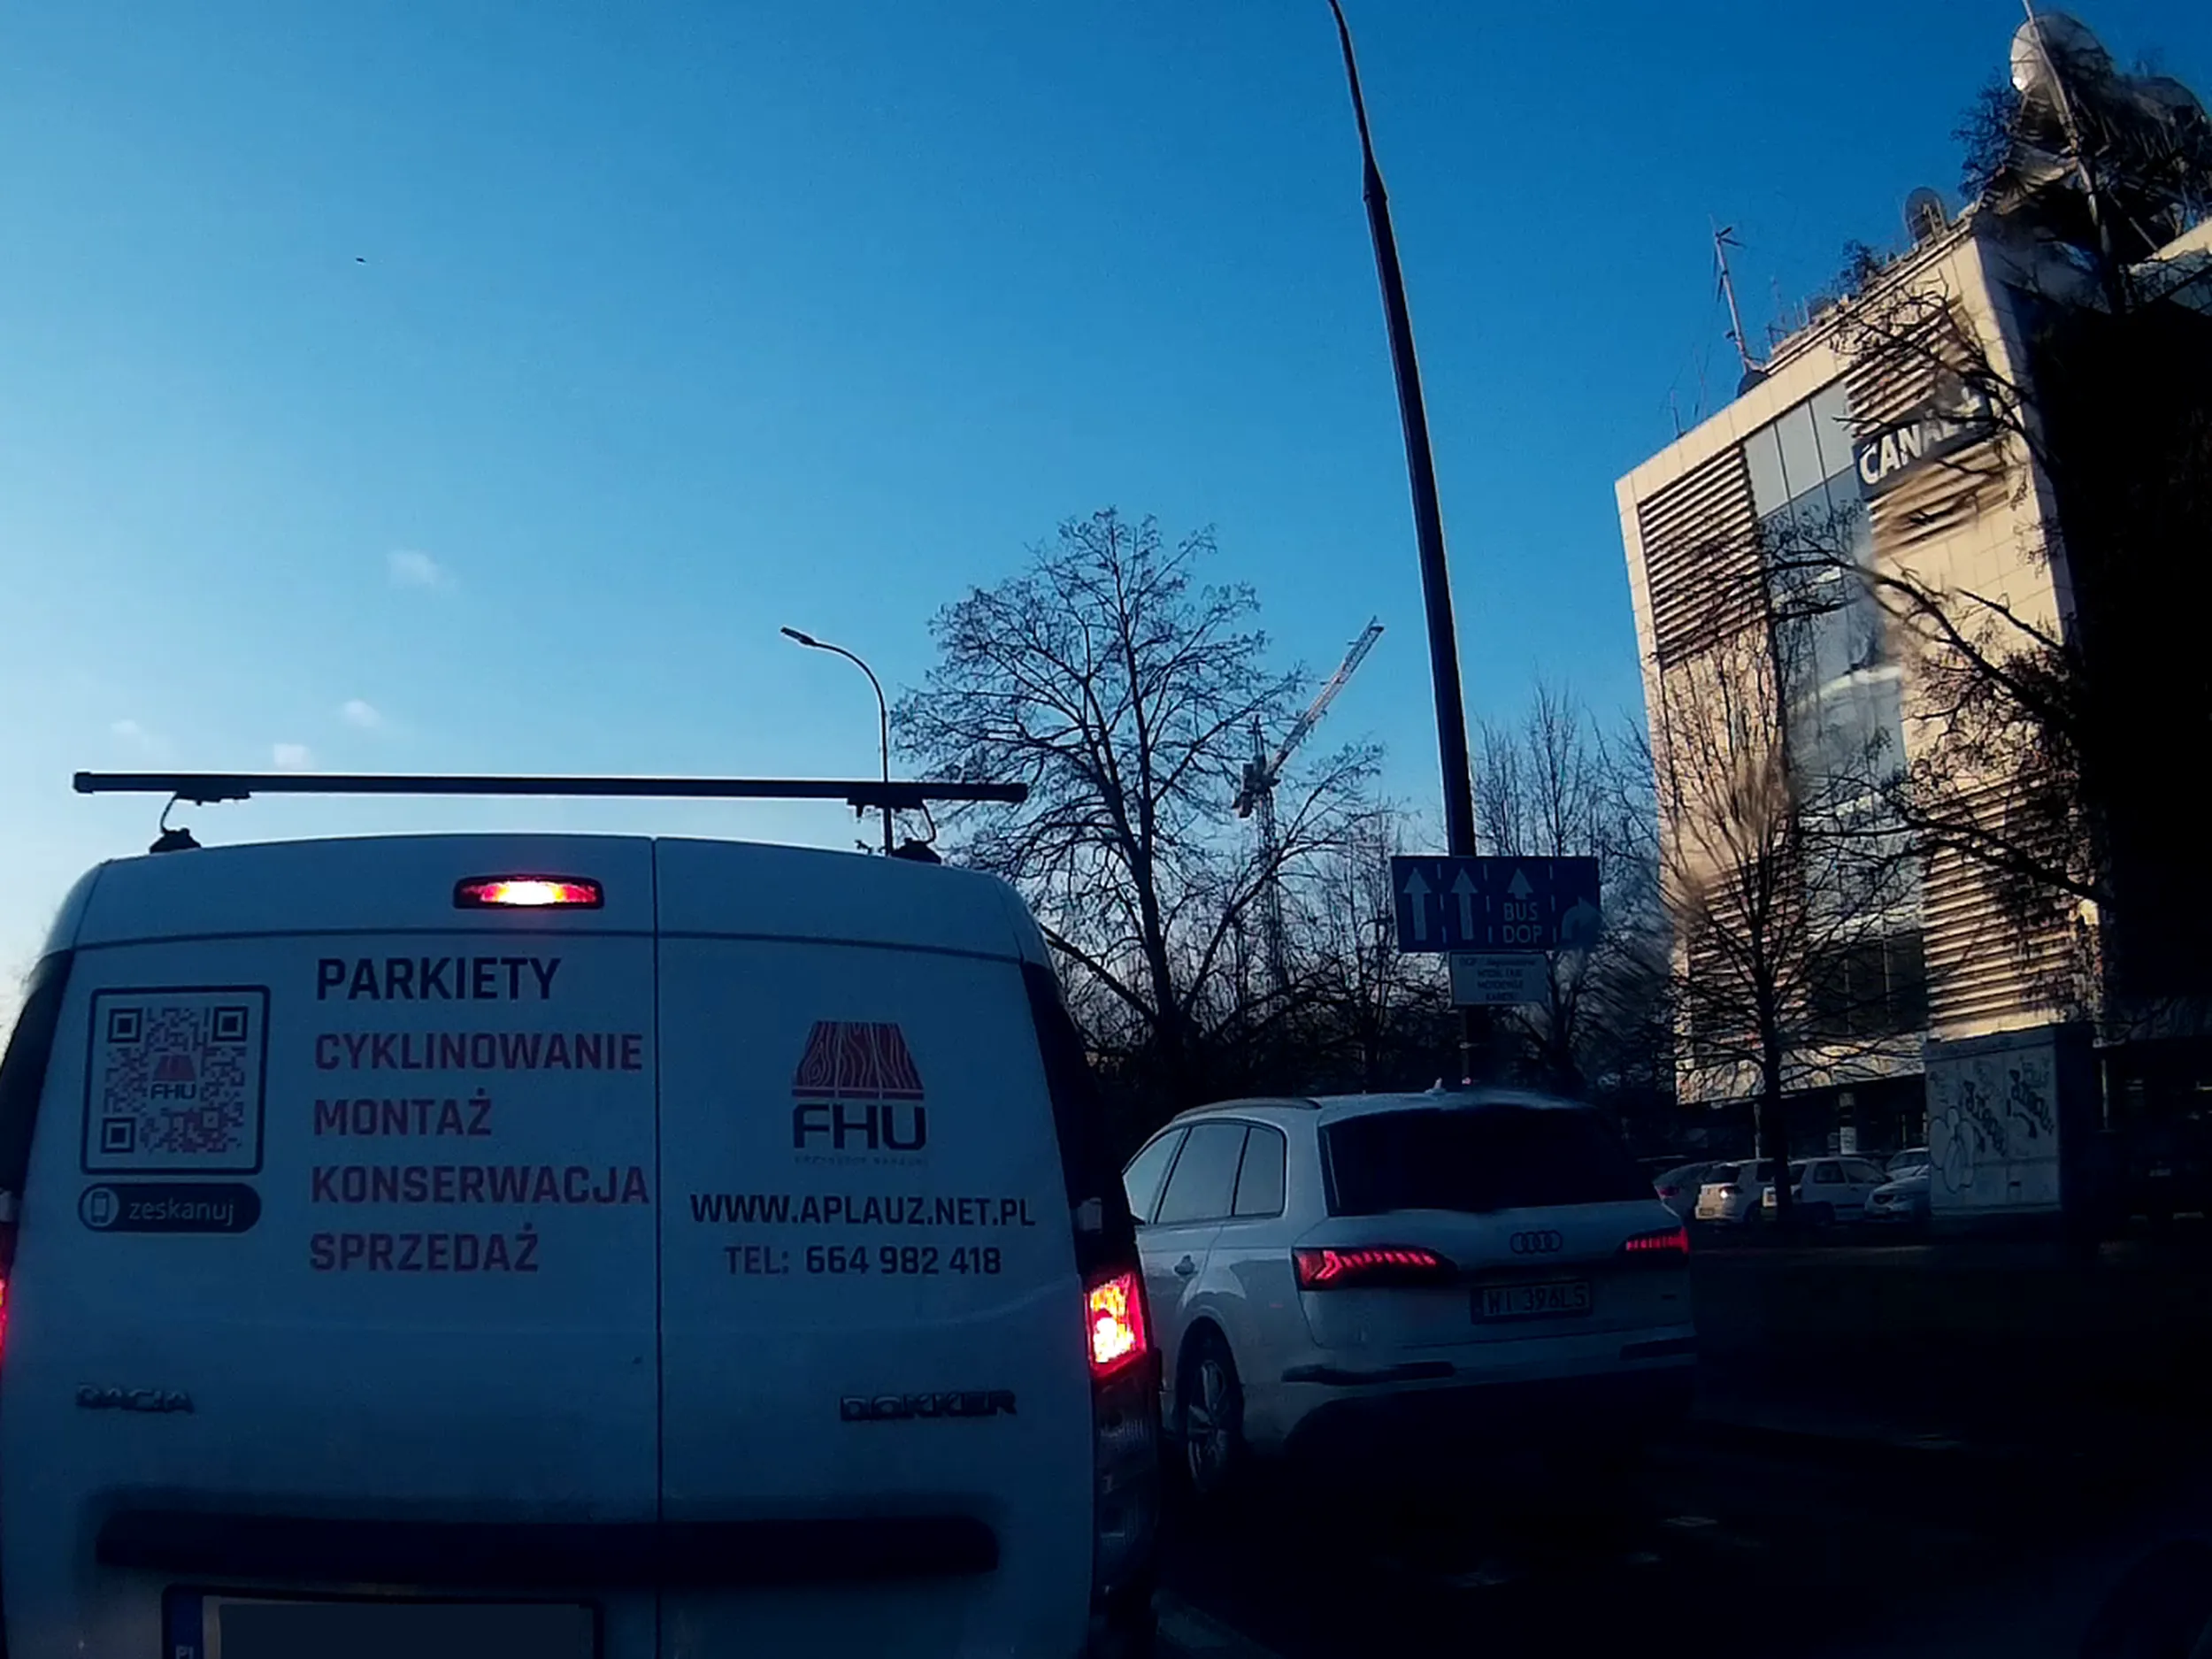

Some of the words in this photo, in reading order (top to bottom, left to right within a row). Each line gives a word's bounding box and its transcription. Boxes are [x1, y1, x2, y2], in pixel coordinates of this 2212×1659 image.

[1504, 902, 1538, 921] BUS
[316, 957, 562, 1001] PARKIETY
[314, 1033, 643, 1071] CYKLINOWANIE
[150, 1084, 196, 1099] FHU
[312, 1087, 493, 1137] MONTAŻ
[792, 1104, 927, 1151] FHU
[311, 1164, 650, 1204] KONSERWACJA
[128, 1198, 234, 1226] zeskanuj
[690, 1194, 1036, 1226] WWW.APLAUZ.NET.PL
[309, 1223, 539, 1272] SPRZEDAŻ
[725, 1245, 789, 1274] TEL:
[806, 1246, 870, 1274] 664
[879, 1247, 940, 1274] 982
[949, 1248, 1002, 1274] 418
[841, 1390, 1017, 1421] DOKKER
